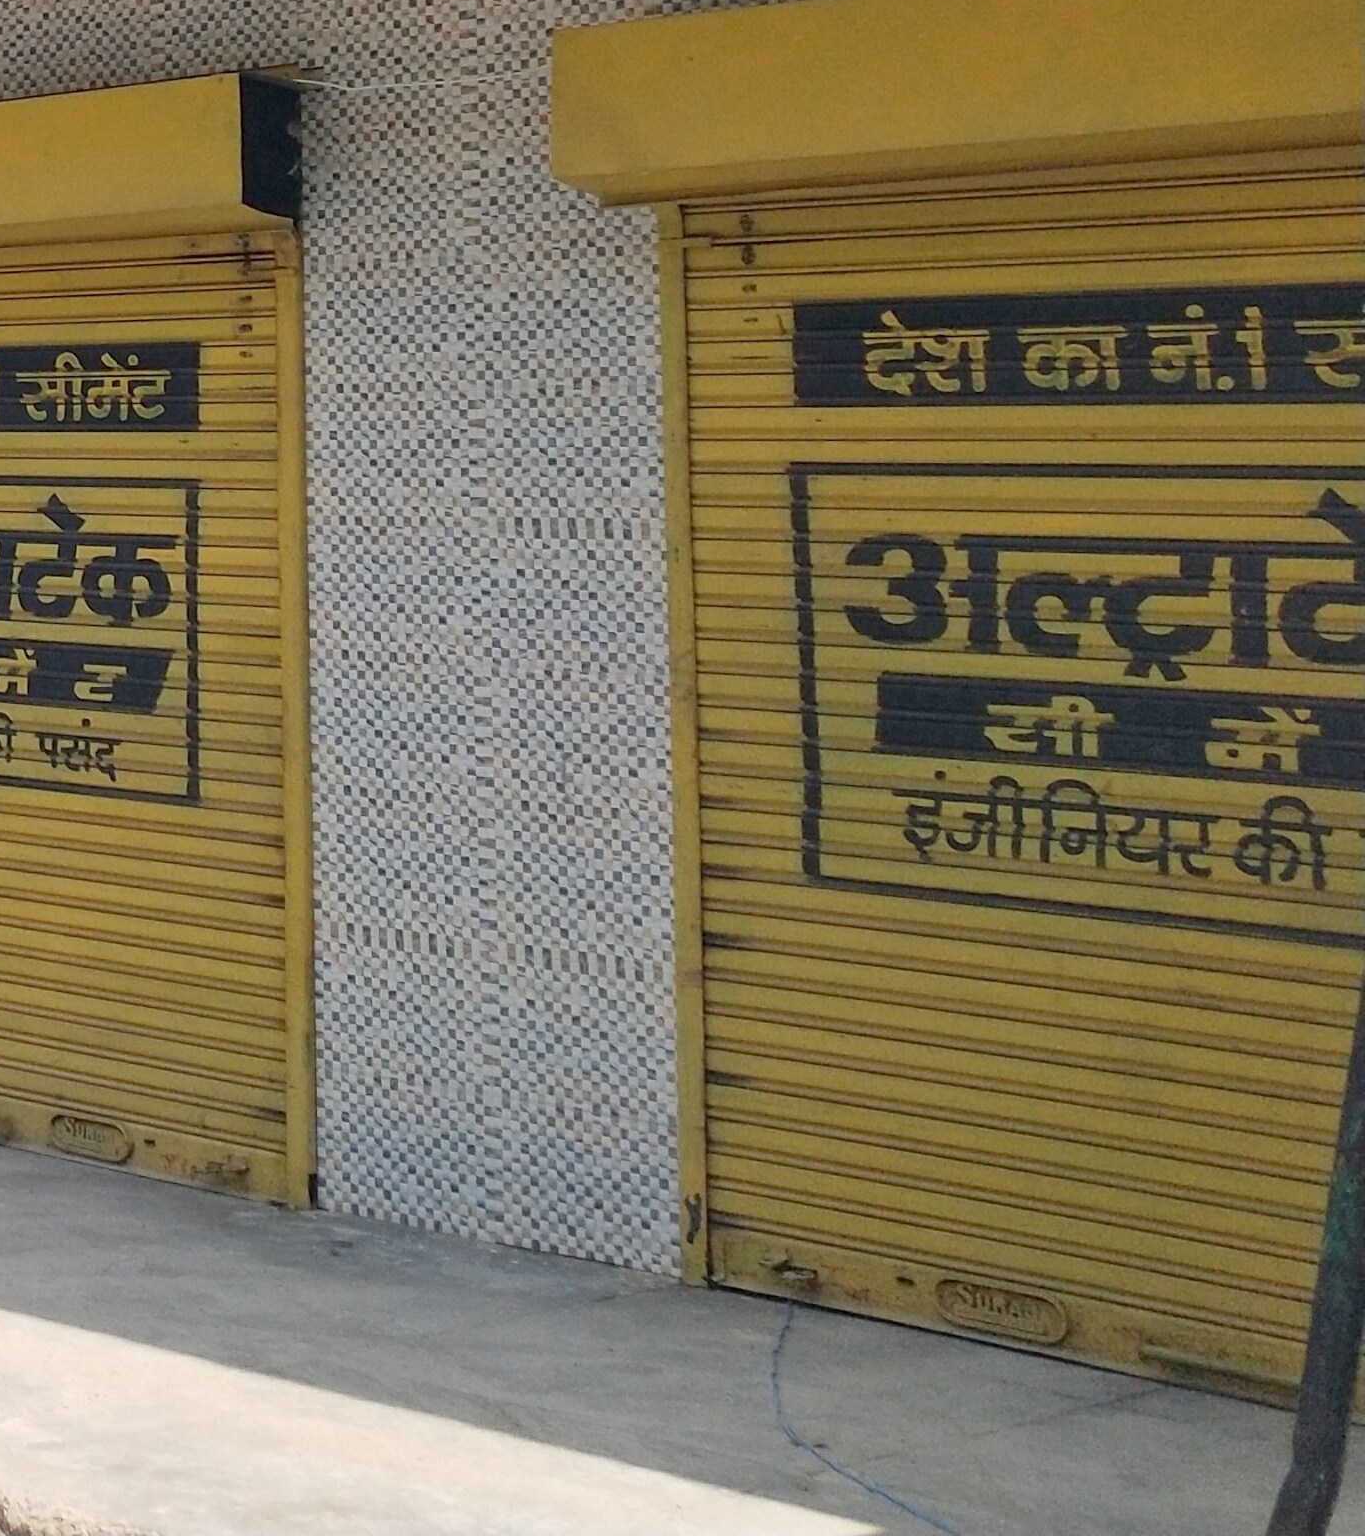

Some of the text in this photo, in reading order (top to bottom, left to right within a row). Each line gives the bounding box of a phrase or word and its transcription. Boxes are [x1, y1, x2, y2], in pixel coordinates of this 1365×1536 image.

[15, 351, 171, 422] सीमेंट
[862, 309, 990, 396] देश
[1017, 325, 1129, 392] का
[35, 718, 122, 783] पसंद
[891, 770, 1333, 890] इंजीनियर की
